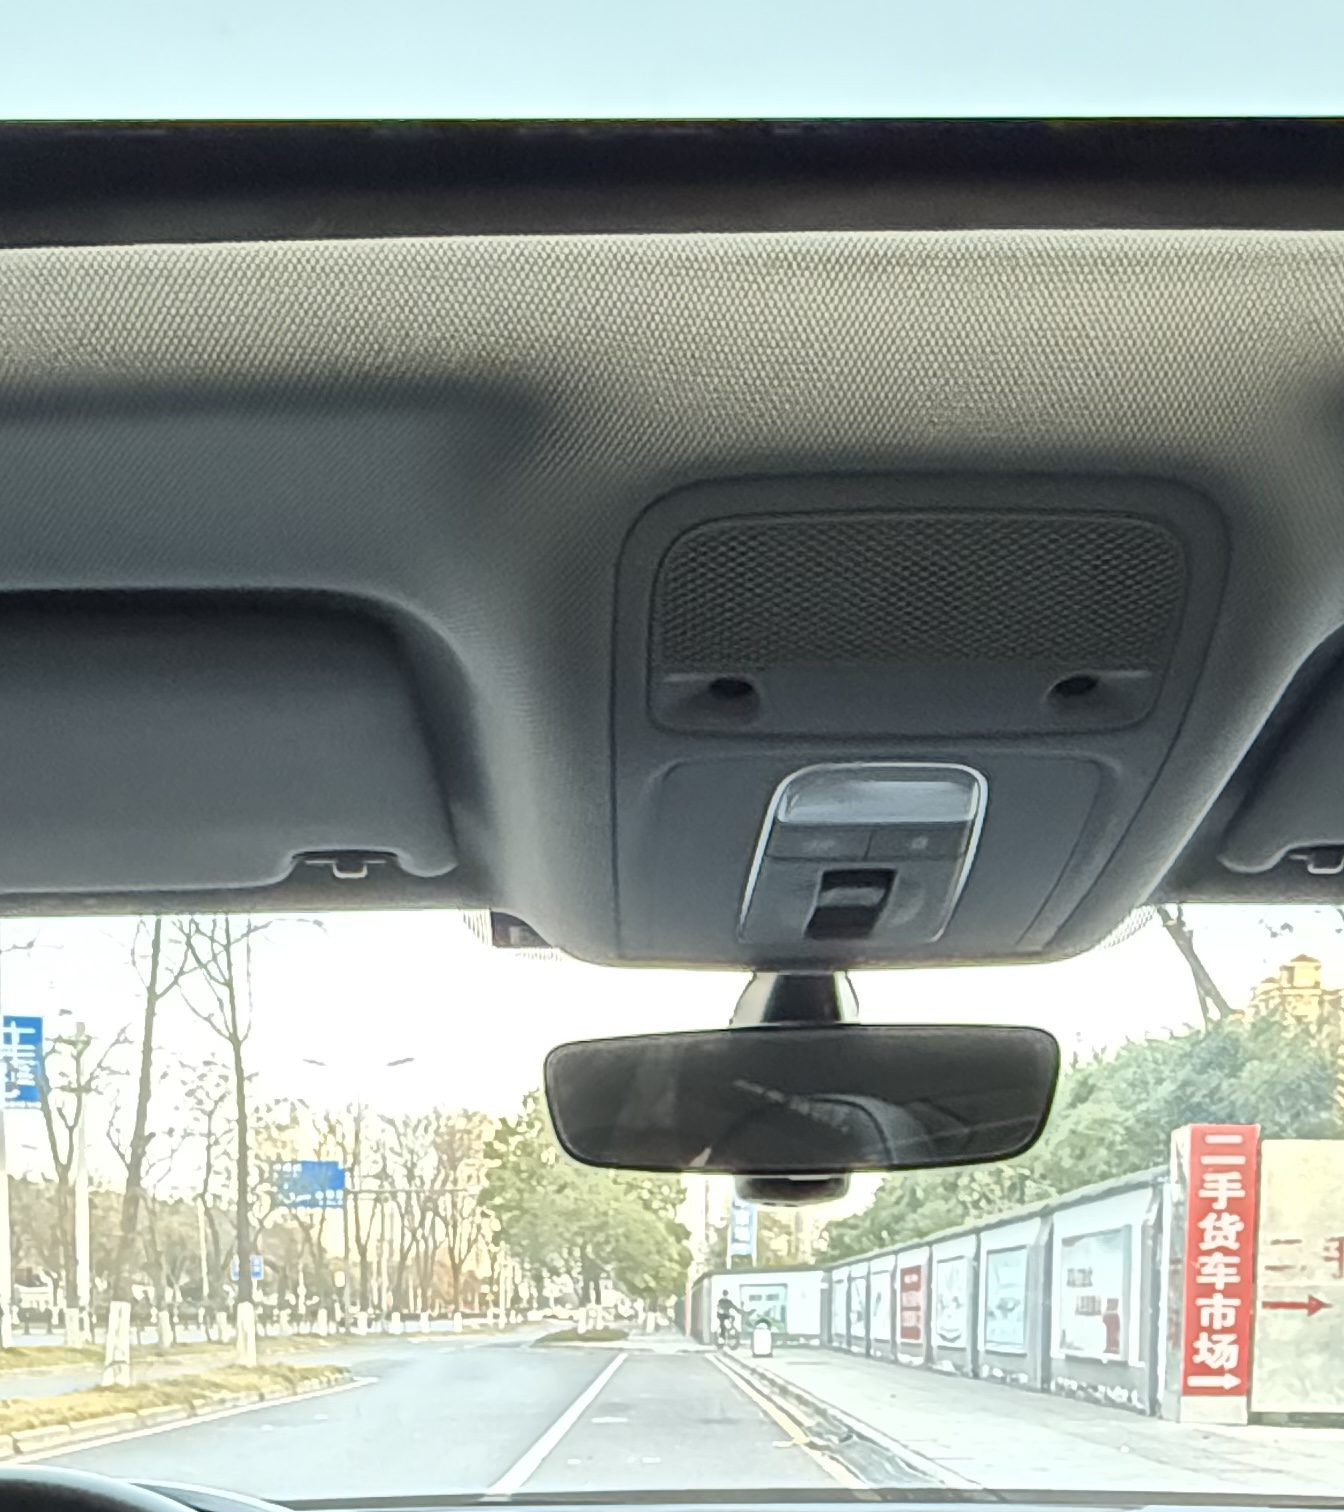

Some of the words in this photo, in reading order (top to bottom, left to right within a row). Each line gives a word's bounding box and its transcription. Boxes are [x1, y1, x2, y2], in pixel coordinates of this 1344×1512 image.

[1192, 1133, 1247, 1371] 二手货车市场
